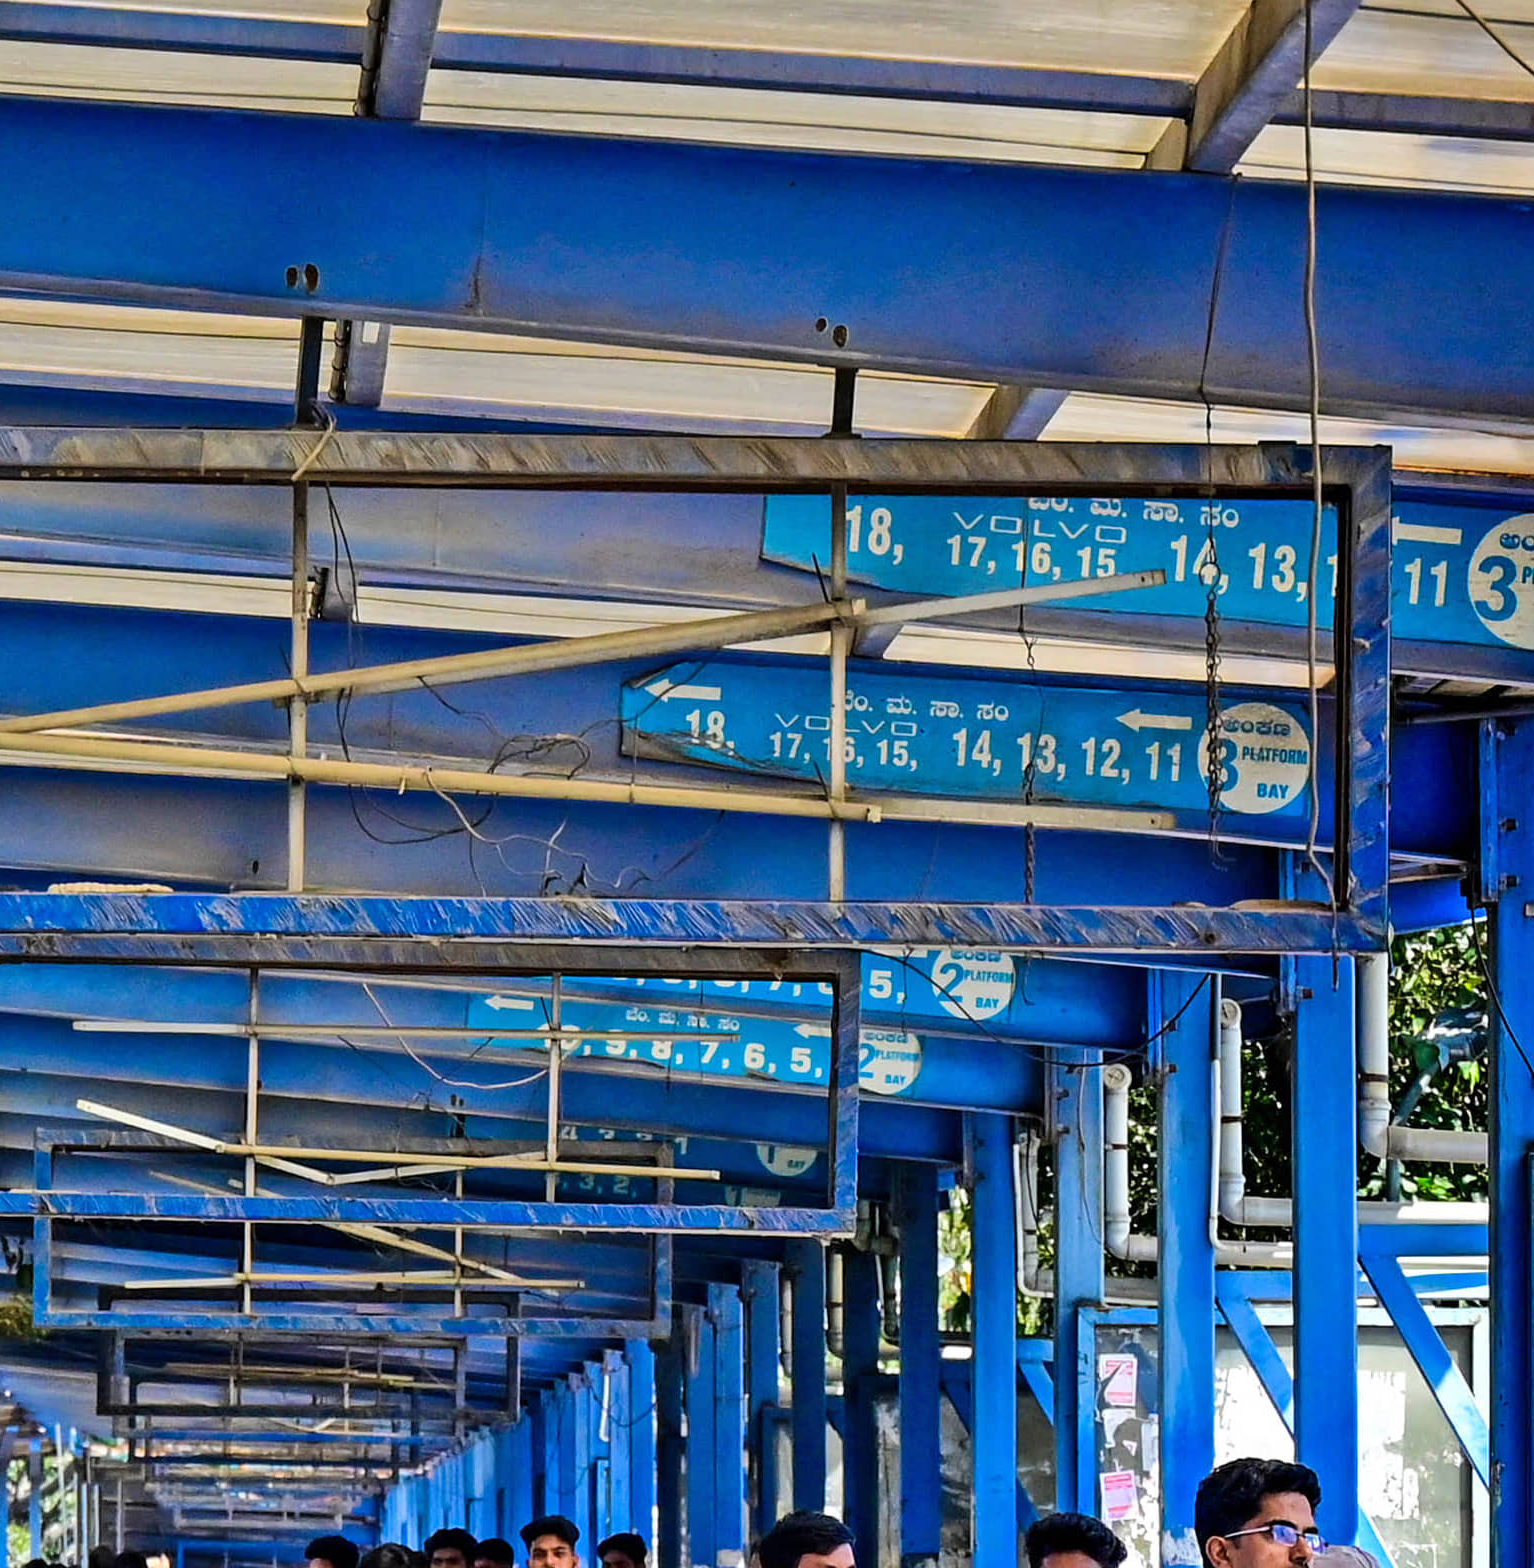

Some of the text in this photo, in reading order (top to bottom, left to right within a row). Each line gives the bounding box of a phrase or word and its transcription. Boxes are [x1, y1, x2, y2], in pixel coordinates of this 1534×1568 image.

[953, 511, 1127, 544] VOLVO
[846, 504, 905, 566] 18,
[947, 534, 997, 575] 17,
[1011, 538, 1062, 581] 16,
[1171, 534, 1230, 596] 14,
[1248, 543, 1308, 603] 13,
[1403, 556, 1450, 608] 11
[1475, 555, 1519, 623] 3
[769, 731, 811, 765] 17,
[877, 738, 918, 772] 15,
[952, 727, 1003, 777] 14,
[1017, 732, 1066, 782] 13,
[1082, 736, 1131, 785] 12,
[1145, 741, 1181, 782] 11
[1242, 746, 1309, 765] PLATFORM
[1256, 782, 1289, 799] BAY
[940, 962, 964, 1003] 2
[964, 970, 1014, 984] PLATFORM
[975, 997, 999, 1008] BAY
[744, 1042, 776, 1074] 6,
[790, 1047, 823, 1079] 5,
[875, 1049, 920, 1062] PLATFORM
[885, 1074, 906, 1085] BAY
